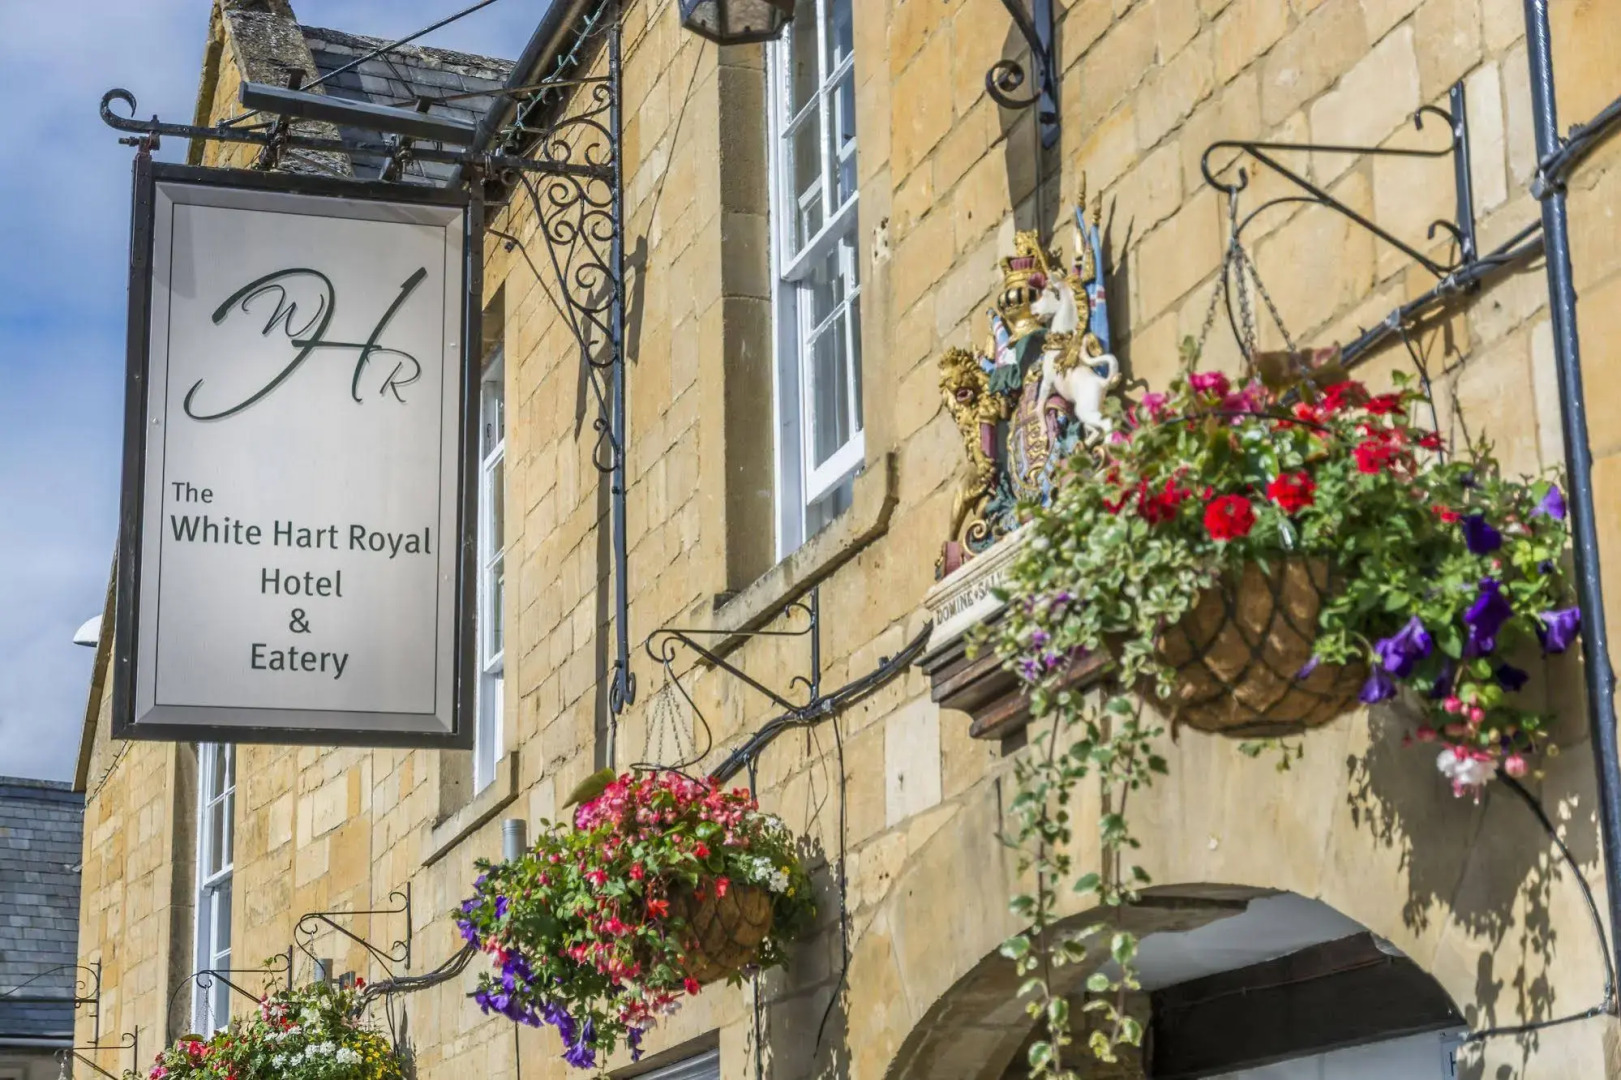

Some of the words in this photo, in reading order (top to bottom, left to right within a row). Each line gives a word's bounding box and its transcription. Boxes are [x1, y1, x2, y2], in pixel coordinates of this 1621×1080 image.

[171, 481, 214, 504] The
[170, 514, 262, 545] White
[273, 519, 339, 550] Hart
[349, 524, 432, 560] Royal
[260, 567, 343, 598] Hotel
[288, 607, 312, 634] &
[936, 590, 974, 626] DOMINE
[250, 643, 350, 681] Eatery
